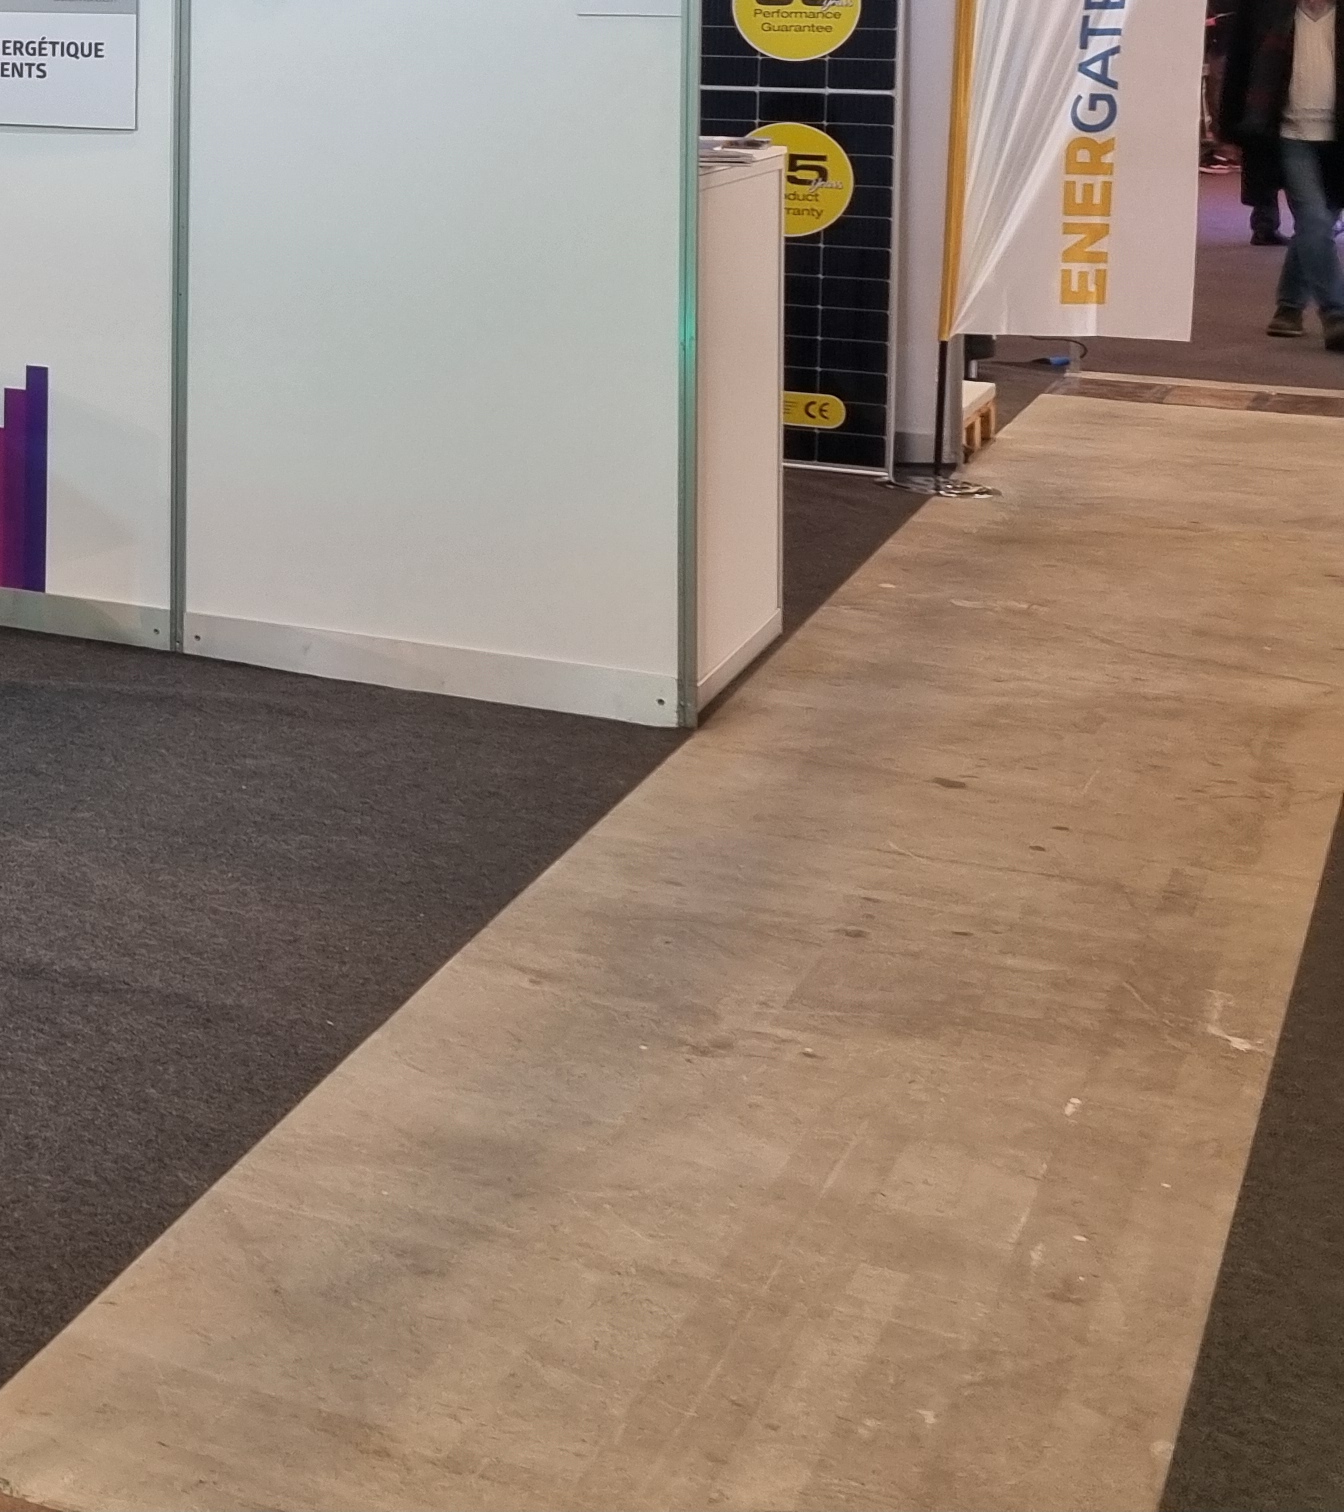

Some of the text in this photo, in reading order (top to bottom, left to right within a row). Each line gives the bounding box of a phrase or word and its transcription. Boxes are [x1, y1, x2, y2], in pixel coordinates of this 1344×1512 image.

[753, 8, 842, 20] Performance
[761, 22, 833, 33] Guarantee
[786, 153, 829, 187] 5
[784, 191, 820, 202] duct
